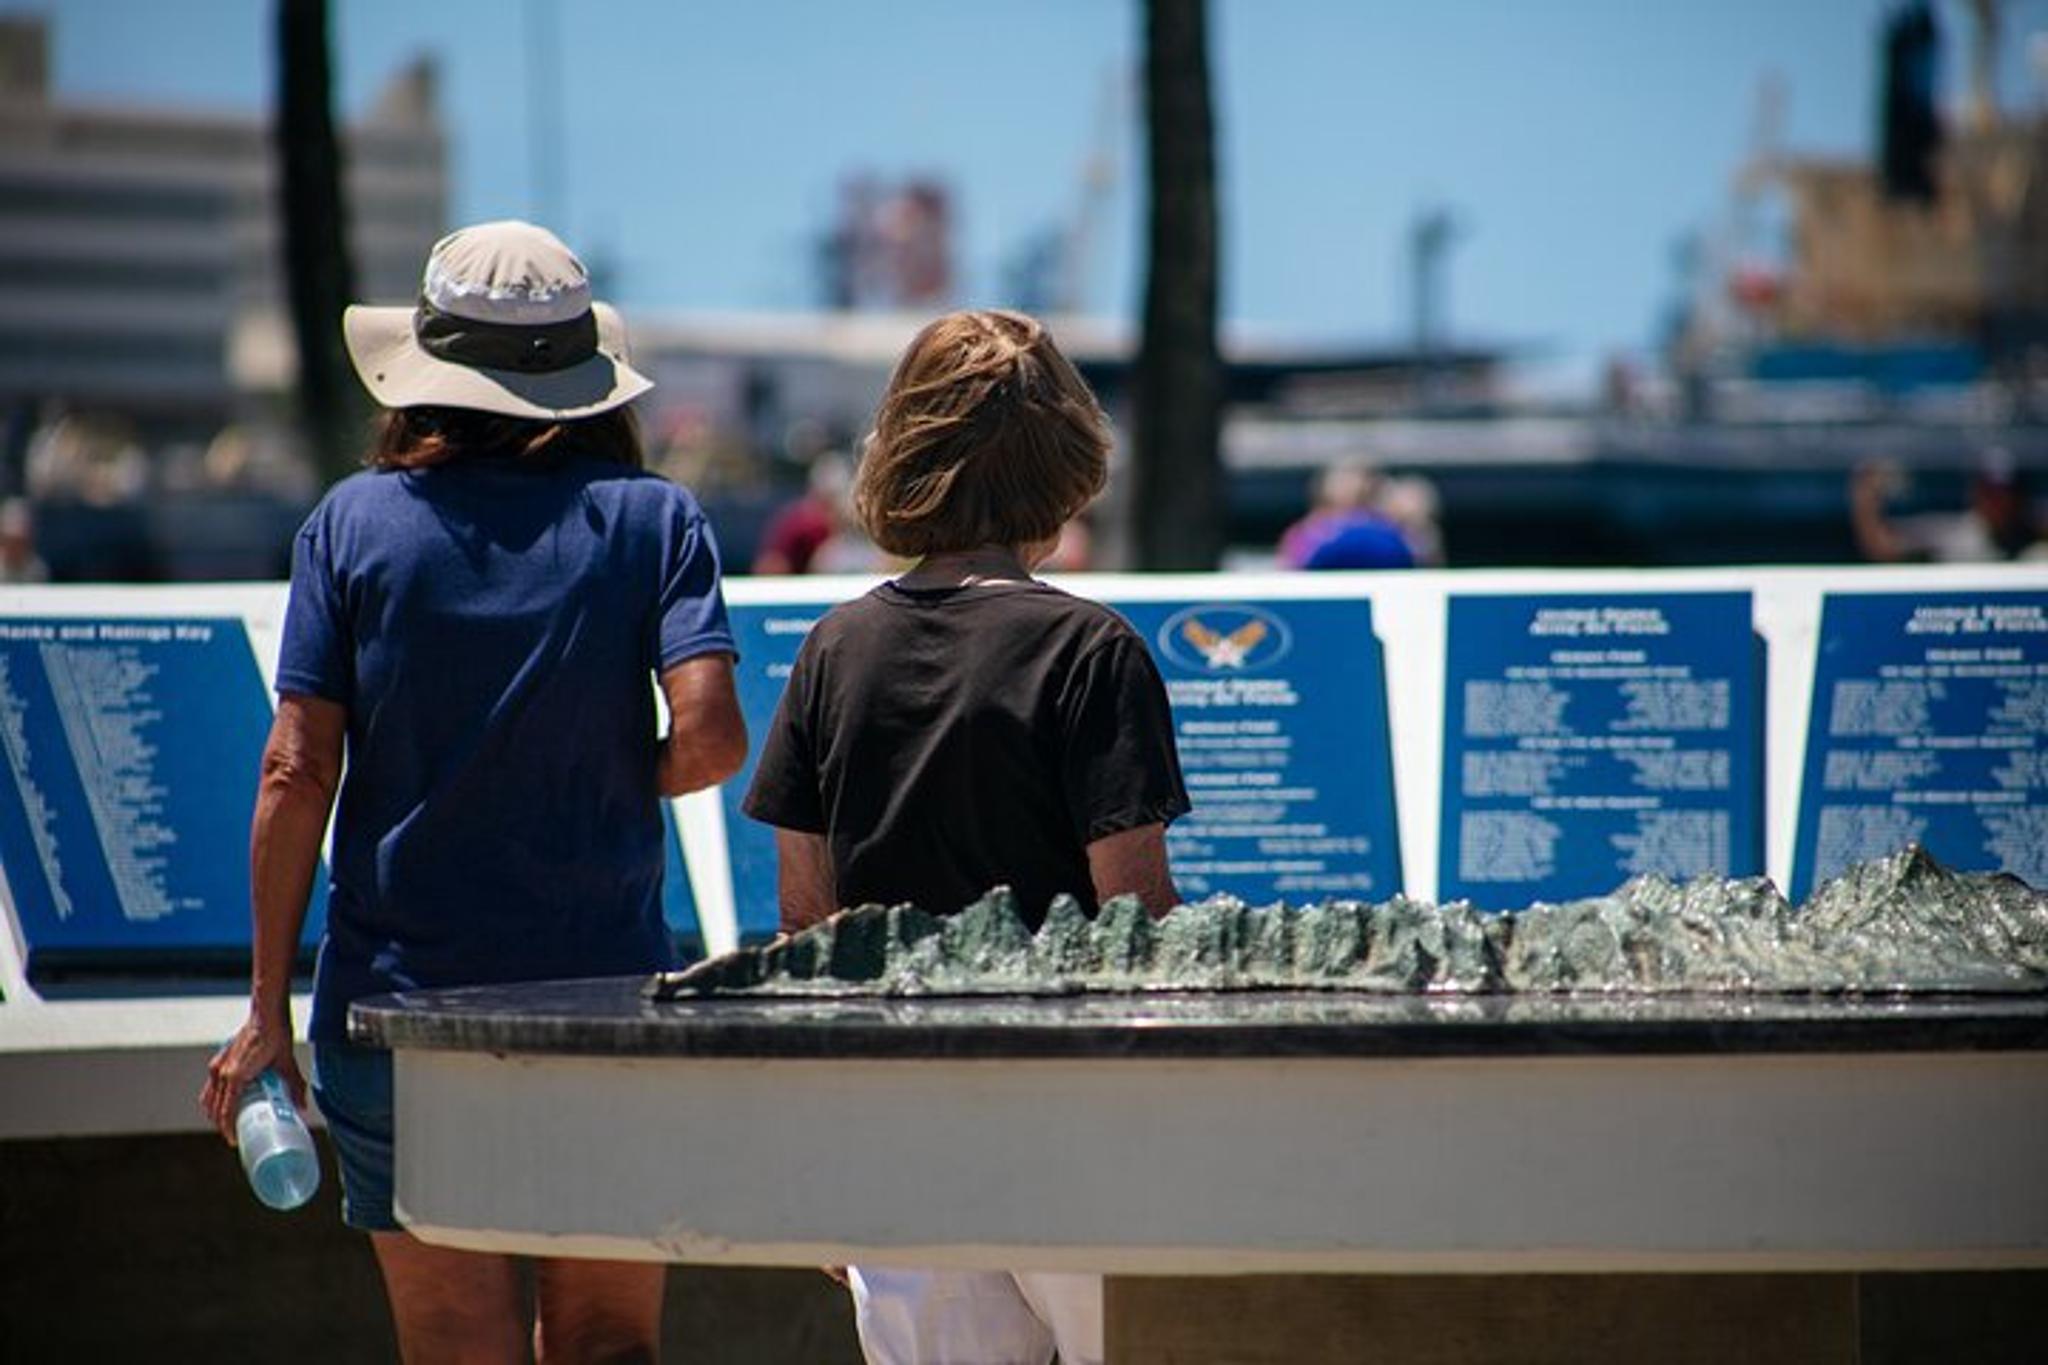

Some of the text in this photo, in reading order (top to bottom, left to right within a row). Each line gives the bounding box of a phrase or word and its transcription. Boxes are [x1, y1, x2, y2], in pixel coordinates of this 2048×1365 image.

[60, 625, 96, 640] and
[101, 625, 171, 642] Ratings
[176, 626, 212, 642] Key
